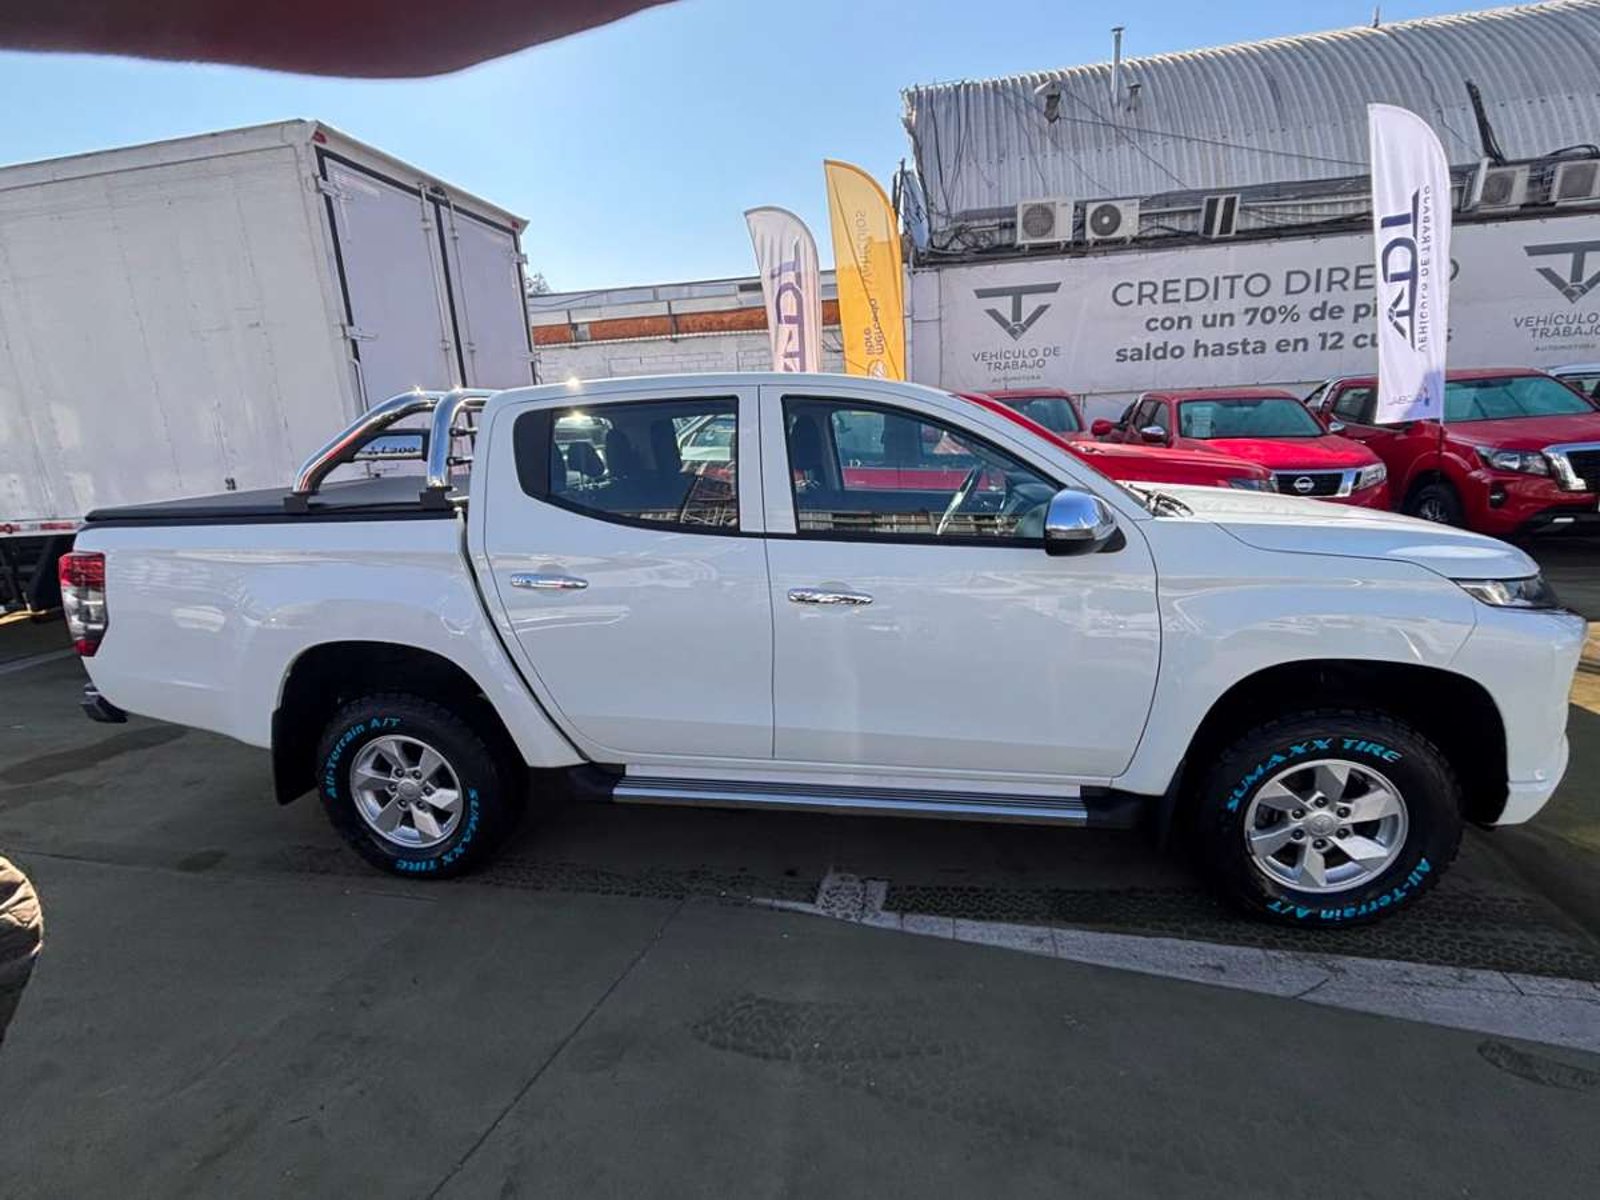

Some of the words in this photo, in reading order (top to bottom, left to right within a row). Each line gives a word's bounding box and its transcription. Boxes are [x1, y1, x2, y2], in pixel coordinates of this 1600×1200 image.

[1112, 272, 1271, 307] CREDITO
[1145, 314, 1193, 331] con
[1202, 311, 1235, 328] un
[1244, 304, 1300, 327] 70%
[1309, 301, 1345, 321] de
[1043, 345, 1062, 357] DE
[1115, 341, 1185, 363] saldo
[1193, 338, 1266, 359] hasta
[1275, 337, 1309, 353] en
[1318, 331, 1344, 351] 12
[986, 358, 1046, 371] TRABAJO
[370, 717, 401, 731] A/T
[1226, 737, 1334, 812] SUMAXX
[1342, 738, 1404, 764] TIRE
[1320, 857, 1431, 921] All-Terrain
[1266, 900, 1312, 919] A/T
